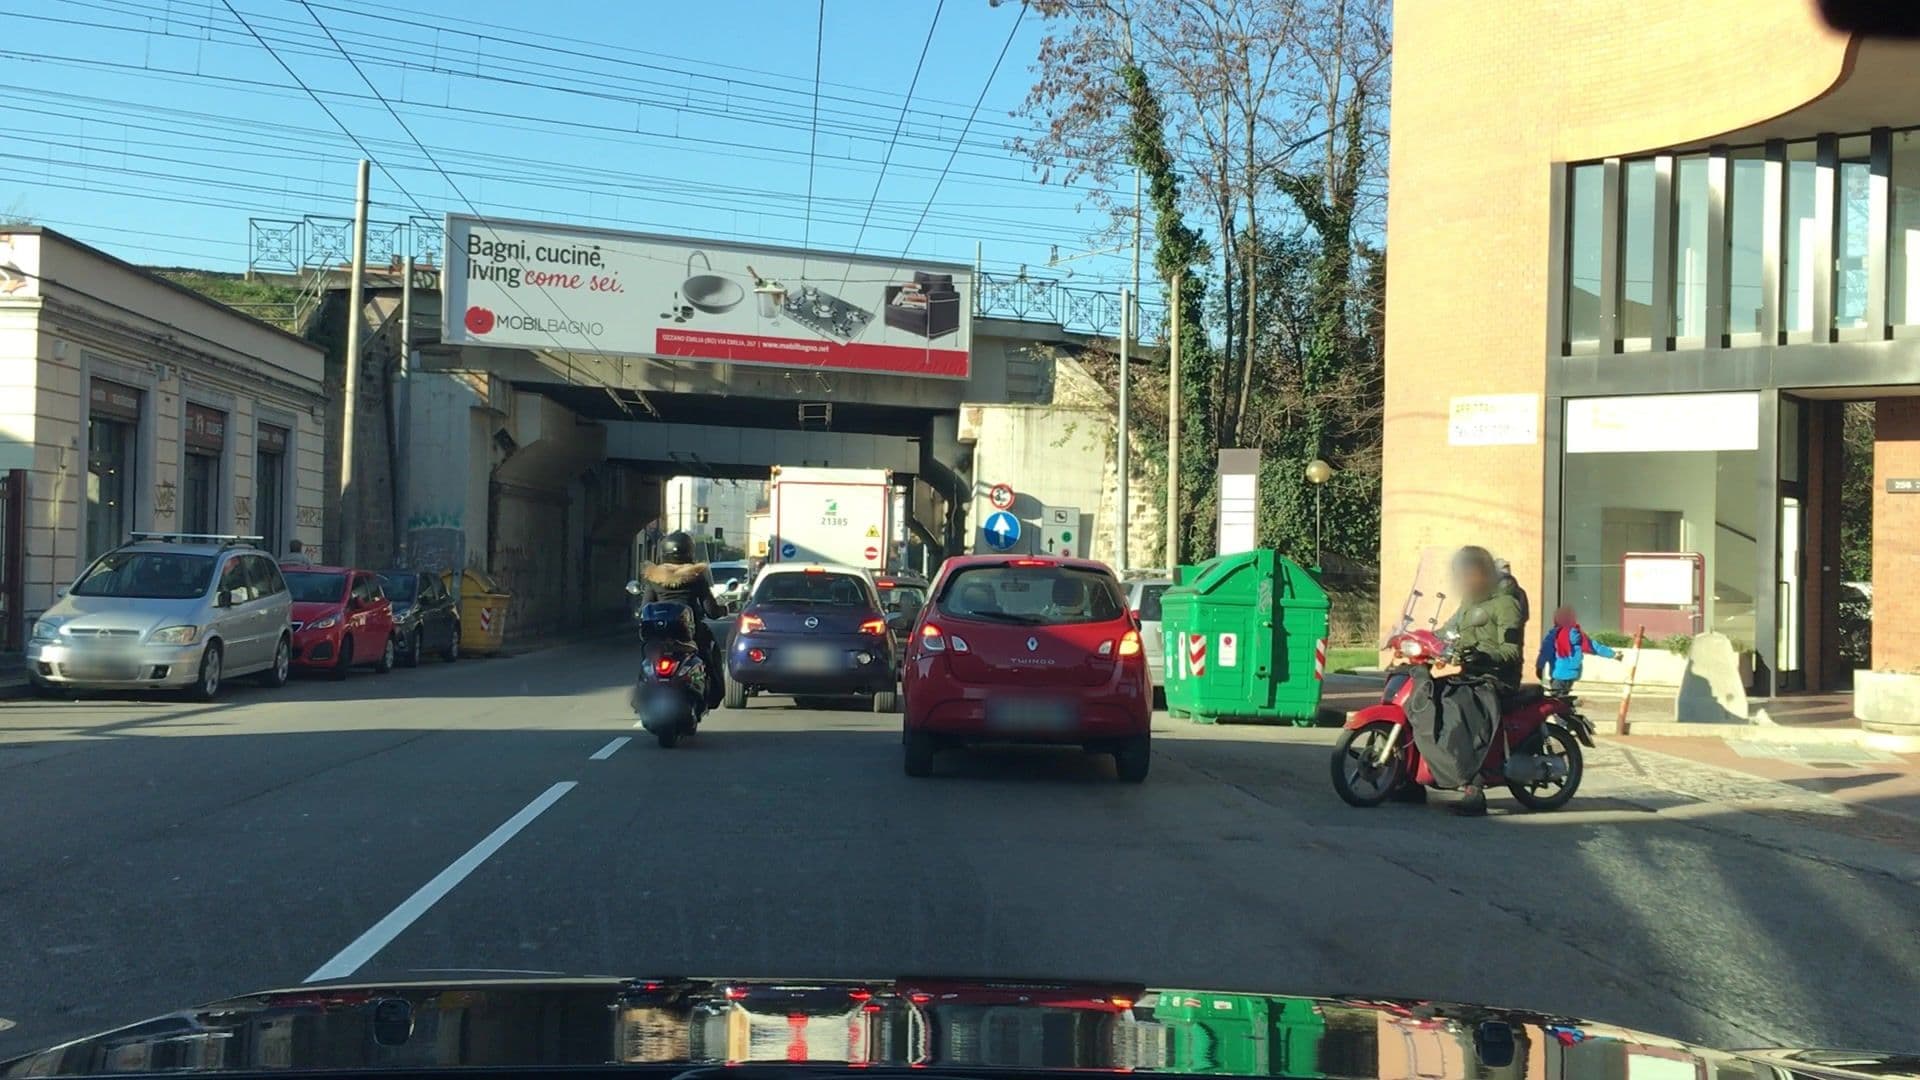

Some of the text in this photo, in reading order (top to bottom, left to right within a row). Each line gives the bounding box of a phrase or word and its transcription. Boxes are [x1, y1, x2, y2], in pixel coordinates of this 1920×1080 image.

[466, 233, 605, 269] Bagni, cucine,
[466, 257, 625, 294] living come sei.
[496, 315, 604, 337] MOBILBAGNO
[1010, 656, 1056, 665] TWINGO
